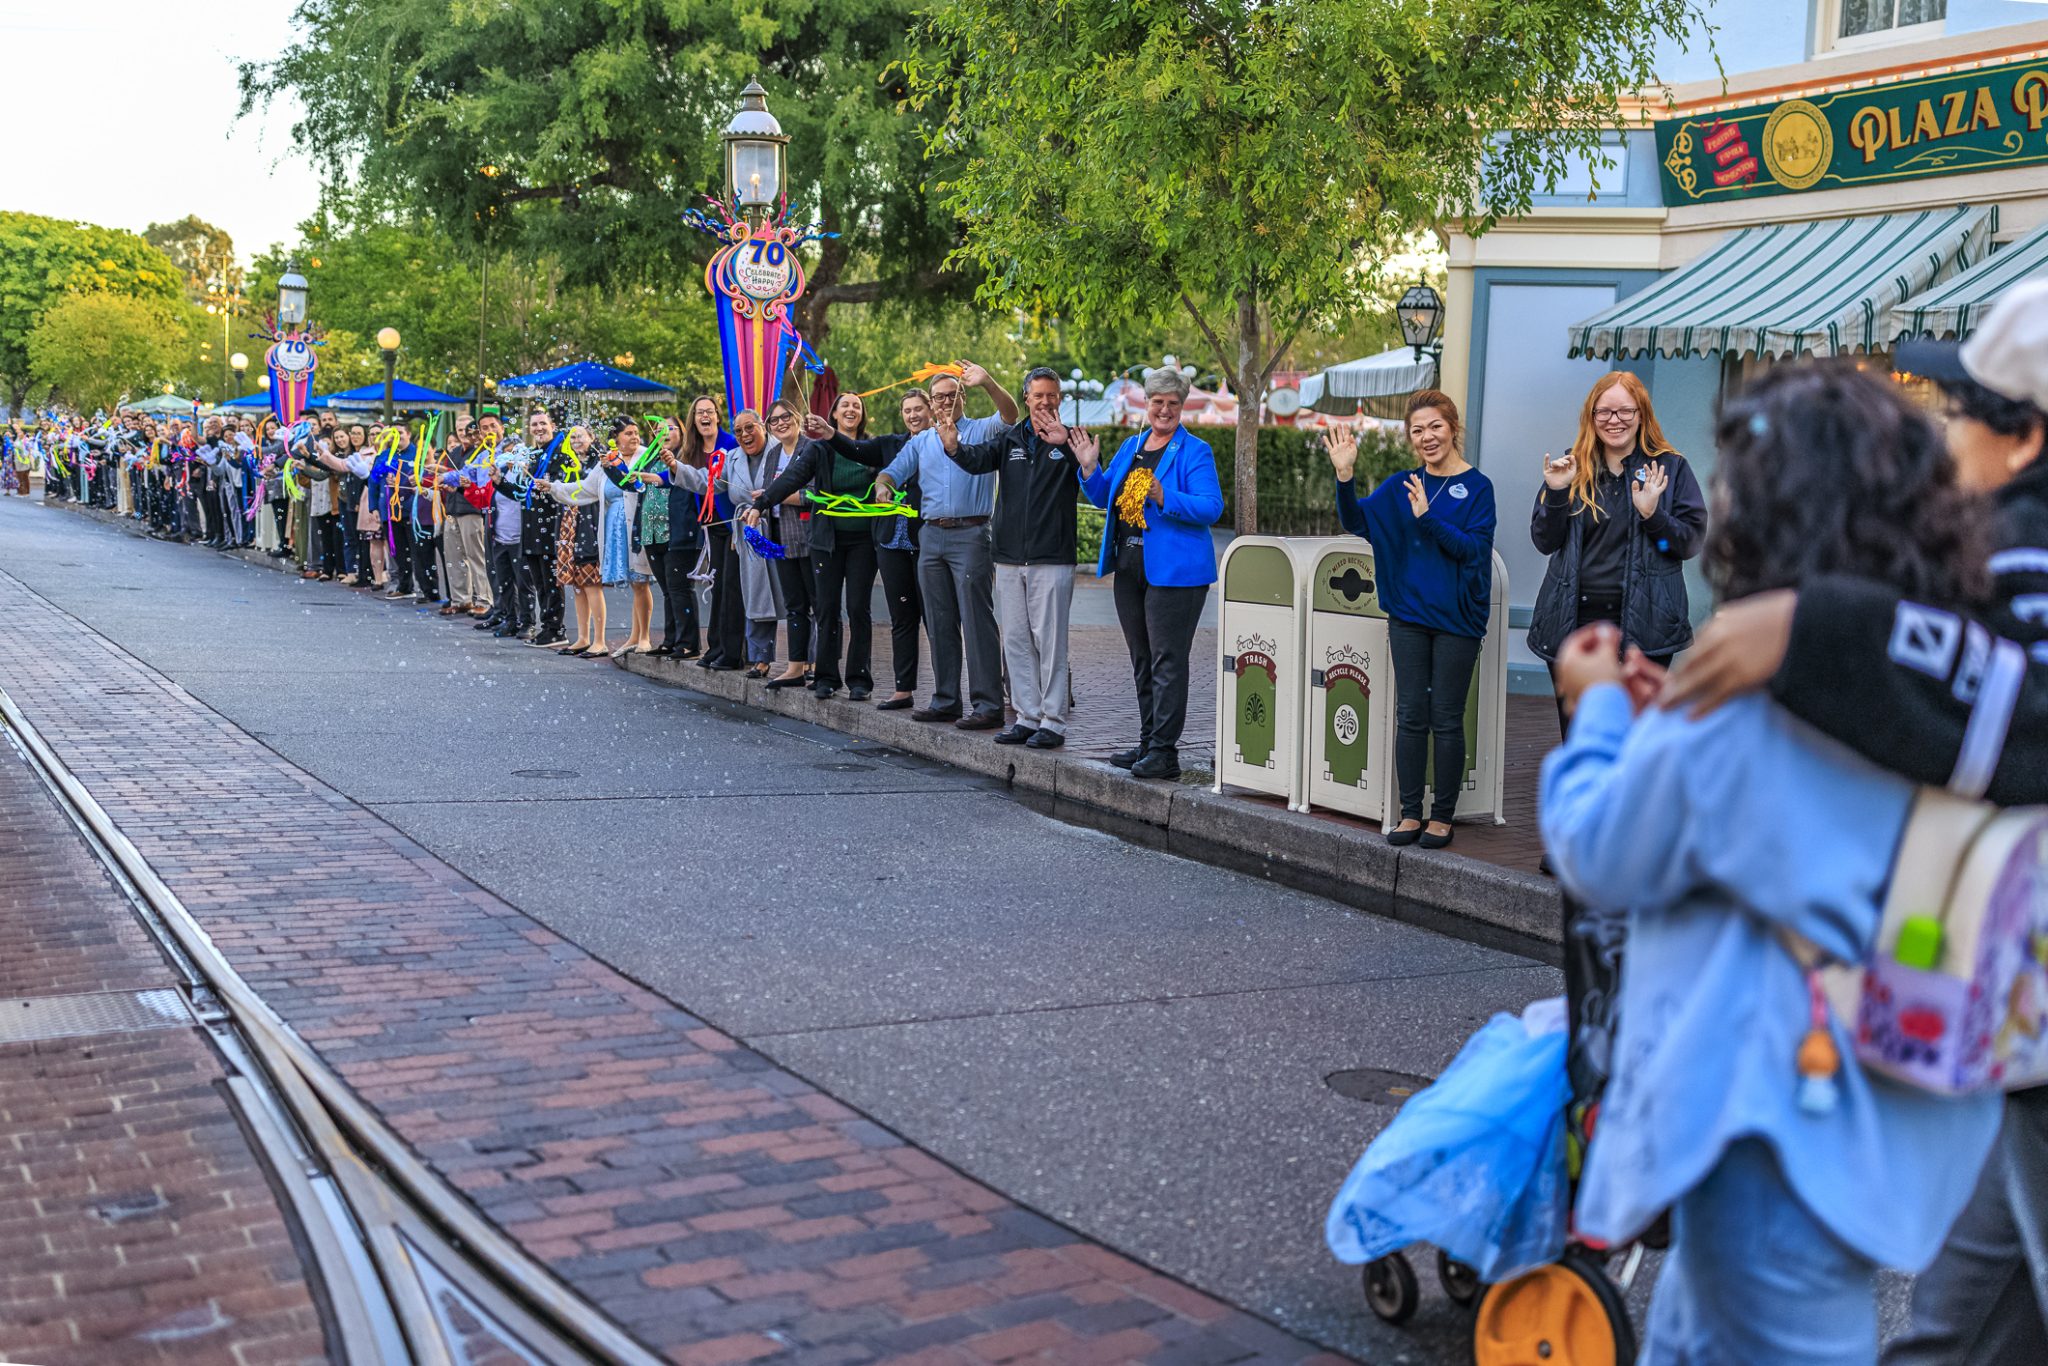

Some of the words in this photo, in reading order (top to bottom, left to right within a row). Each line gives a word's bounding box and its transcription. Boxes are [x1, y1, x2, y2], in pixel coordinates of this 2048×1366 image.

[1849, 86, 2002, 163] PLAZA
[749, 239, 785, 266] 70
[285, 340, 305, 353] 70
[1332, 558, 1347, 574] MIXED
[1347, 557, 1373, 578] RECYCLING
[1244, 654, 1268, 667] TRASH
[1328, 668, 1348, 680] RECYCLE
[1349, 669, 1367, 686] PLEASE
